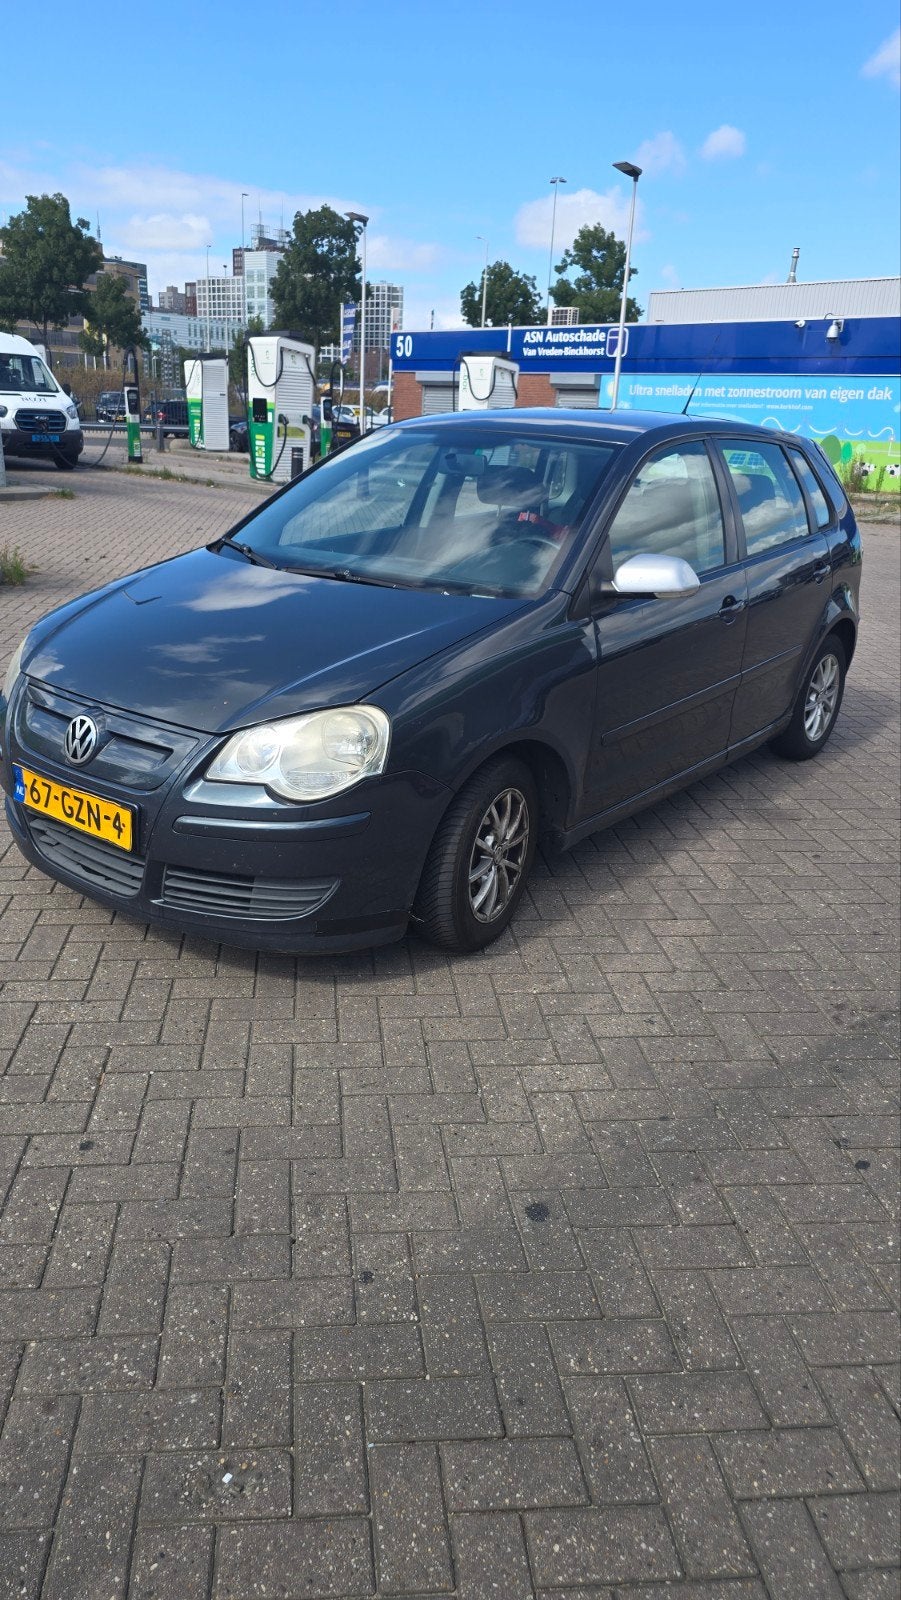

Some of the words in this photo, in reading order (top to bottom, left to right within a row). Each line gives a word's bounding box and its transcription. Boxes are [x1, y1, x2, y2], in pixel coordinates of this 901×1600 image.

[523, 331, 544, 343] ASN
[545, 329, 606, 343] Autoschade
[396, 335, 413, 357] 50
[522, 347, 536, 356] Van
[537, 346, 605, 356] Vreden-Binckhorst
[629, 384, 653, 396] Ultra
[655, 384, 703, 397] snelladen
[704, 387, 726, 397] met
[727, 387, 802, 399] zonnestroom
[805, 388, 827, 399] van
[830, 386, 865, 403] eigen
[867, 386, 893, 400] dak
[15, 785, 25, 795] NL
[29, 778, 125, 839] 67-GZN-4
